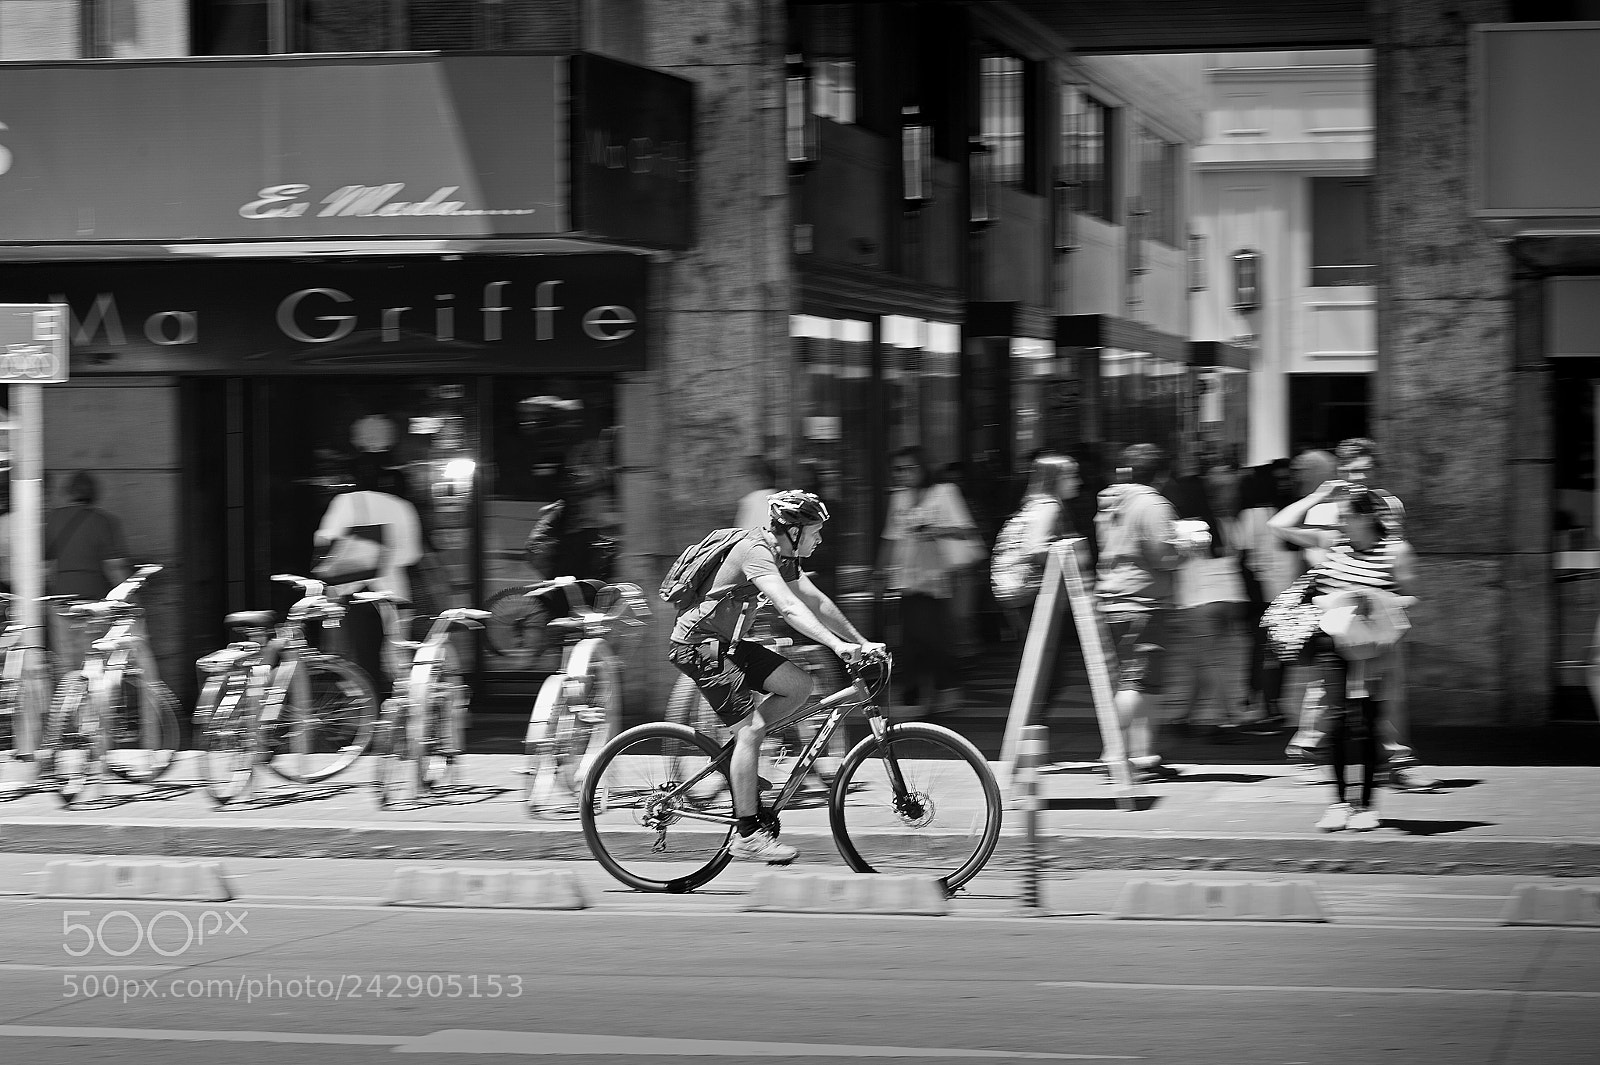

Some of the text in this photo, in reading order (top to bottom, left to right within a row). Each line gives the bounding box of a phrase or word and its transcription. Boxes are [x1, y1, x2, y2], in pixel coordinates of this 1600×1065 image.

[48, 280, 638, 345] Ma Griffe
[799, 708, 842, 767] TREK
